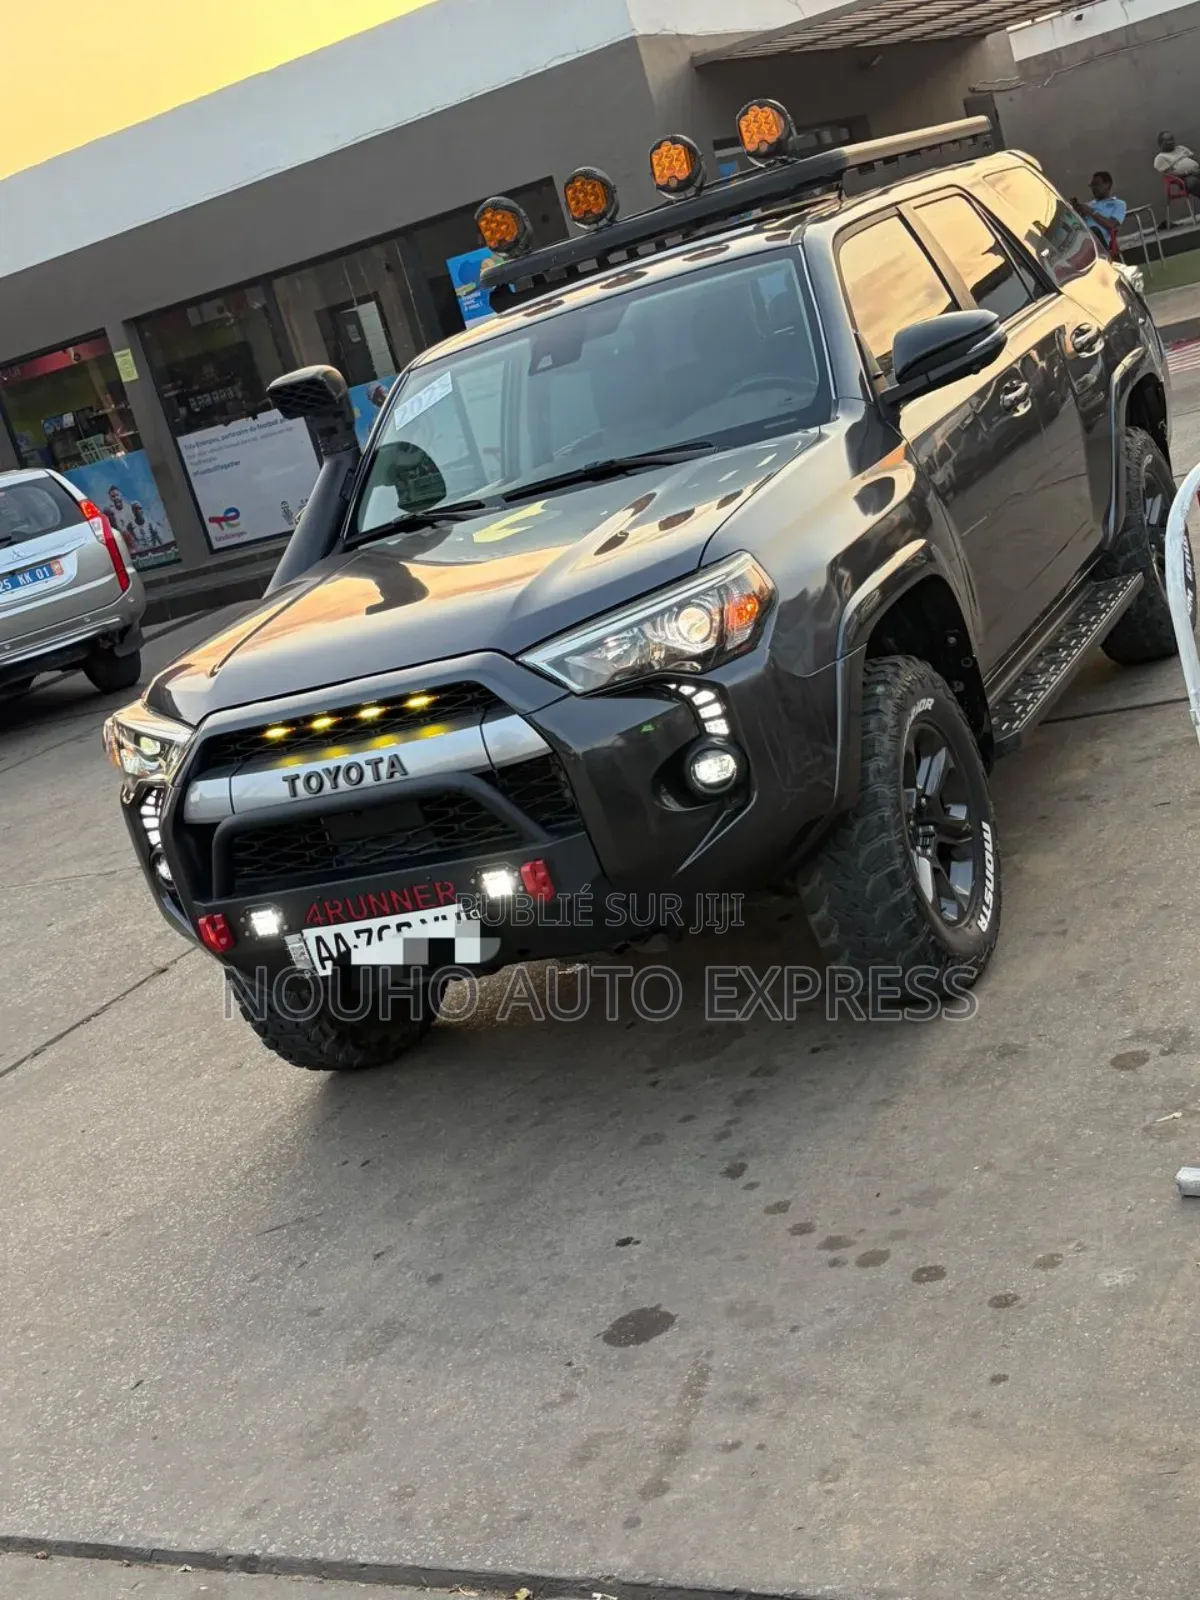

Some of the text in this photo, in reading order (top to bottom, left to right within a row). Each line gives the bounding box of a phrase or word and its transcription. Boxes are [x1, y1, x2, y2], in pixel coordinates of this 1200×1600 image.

[17, 571, 34, 586] KK
[282, 753, 409, 798] TOYOTA
[304, 880, 458, 926] 4RUNNER
